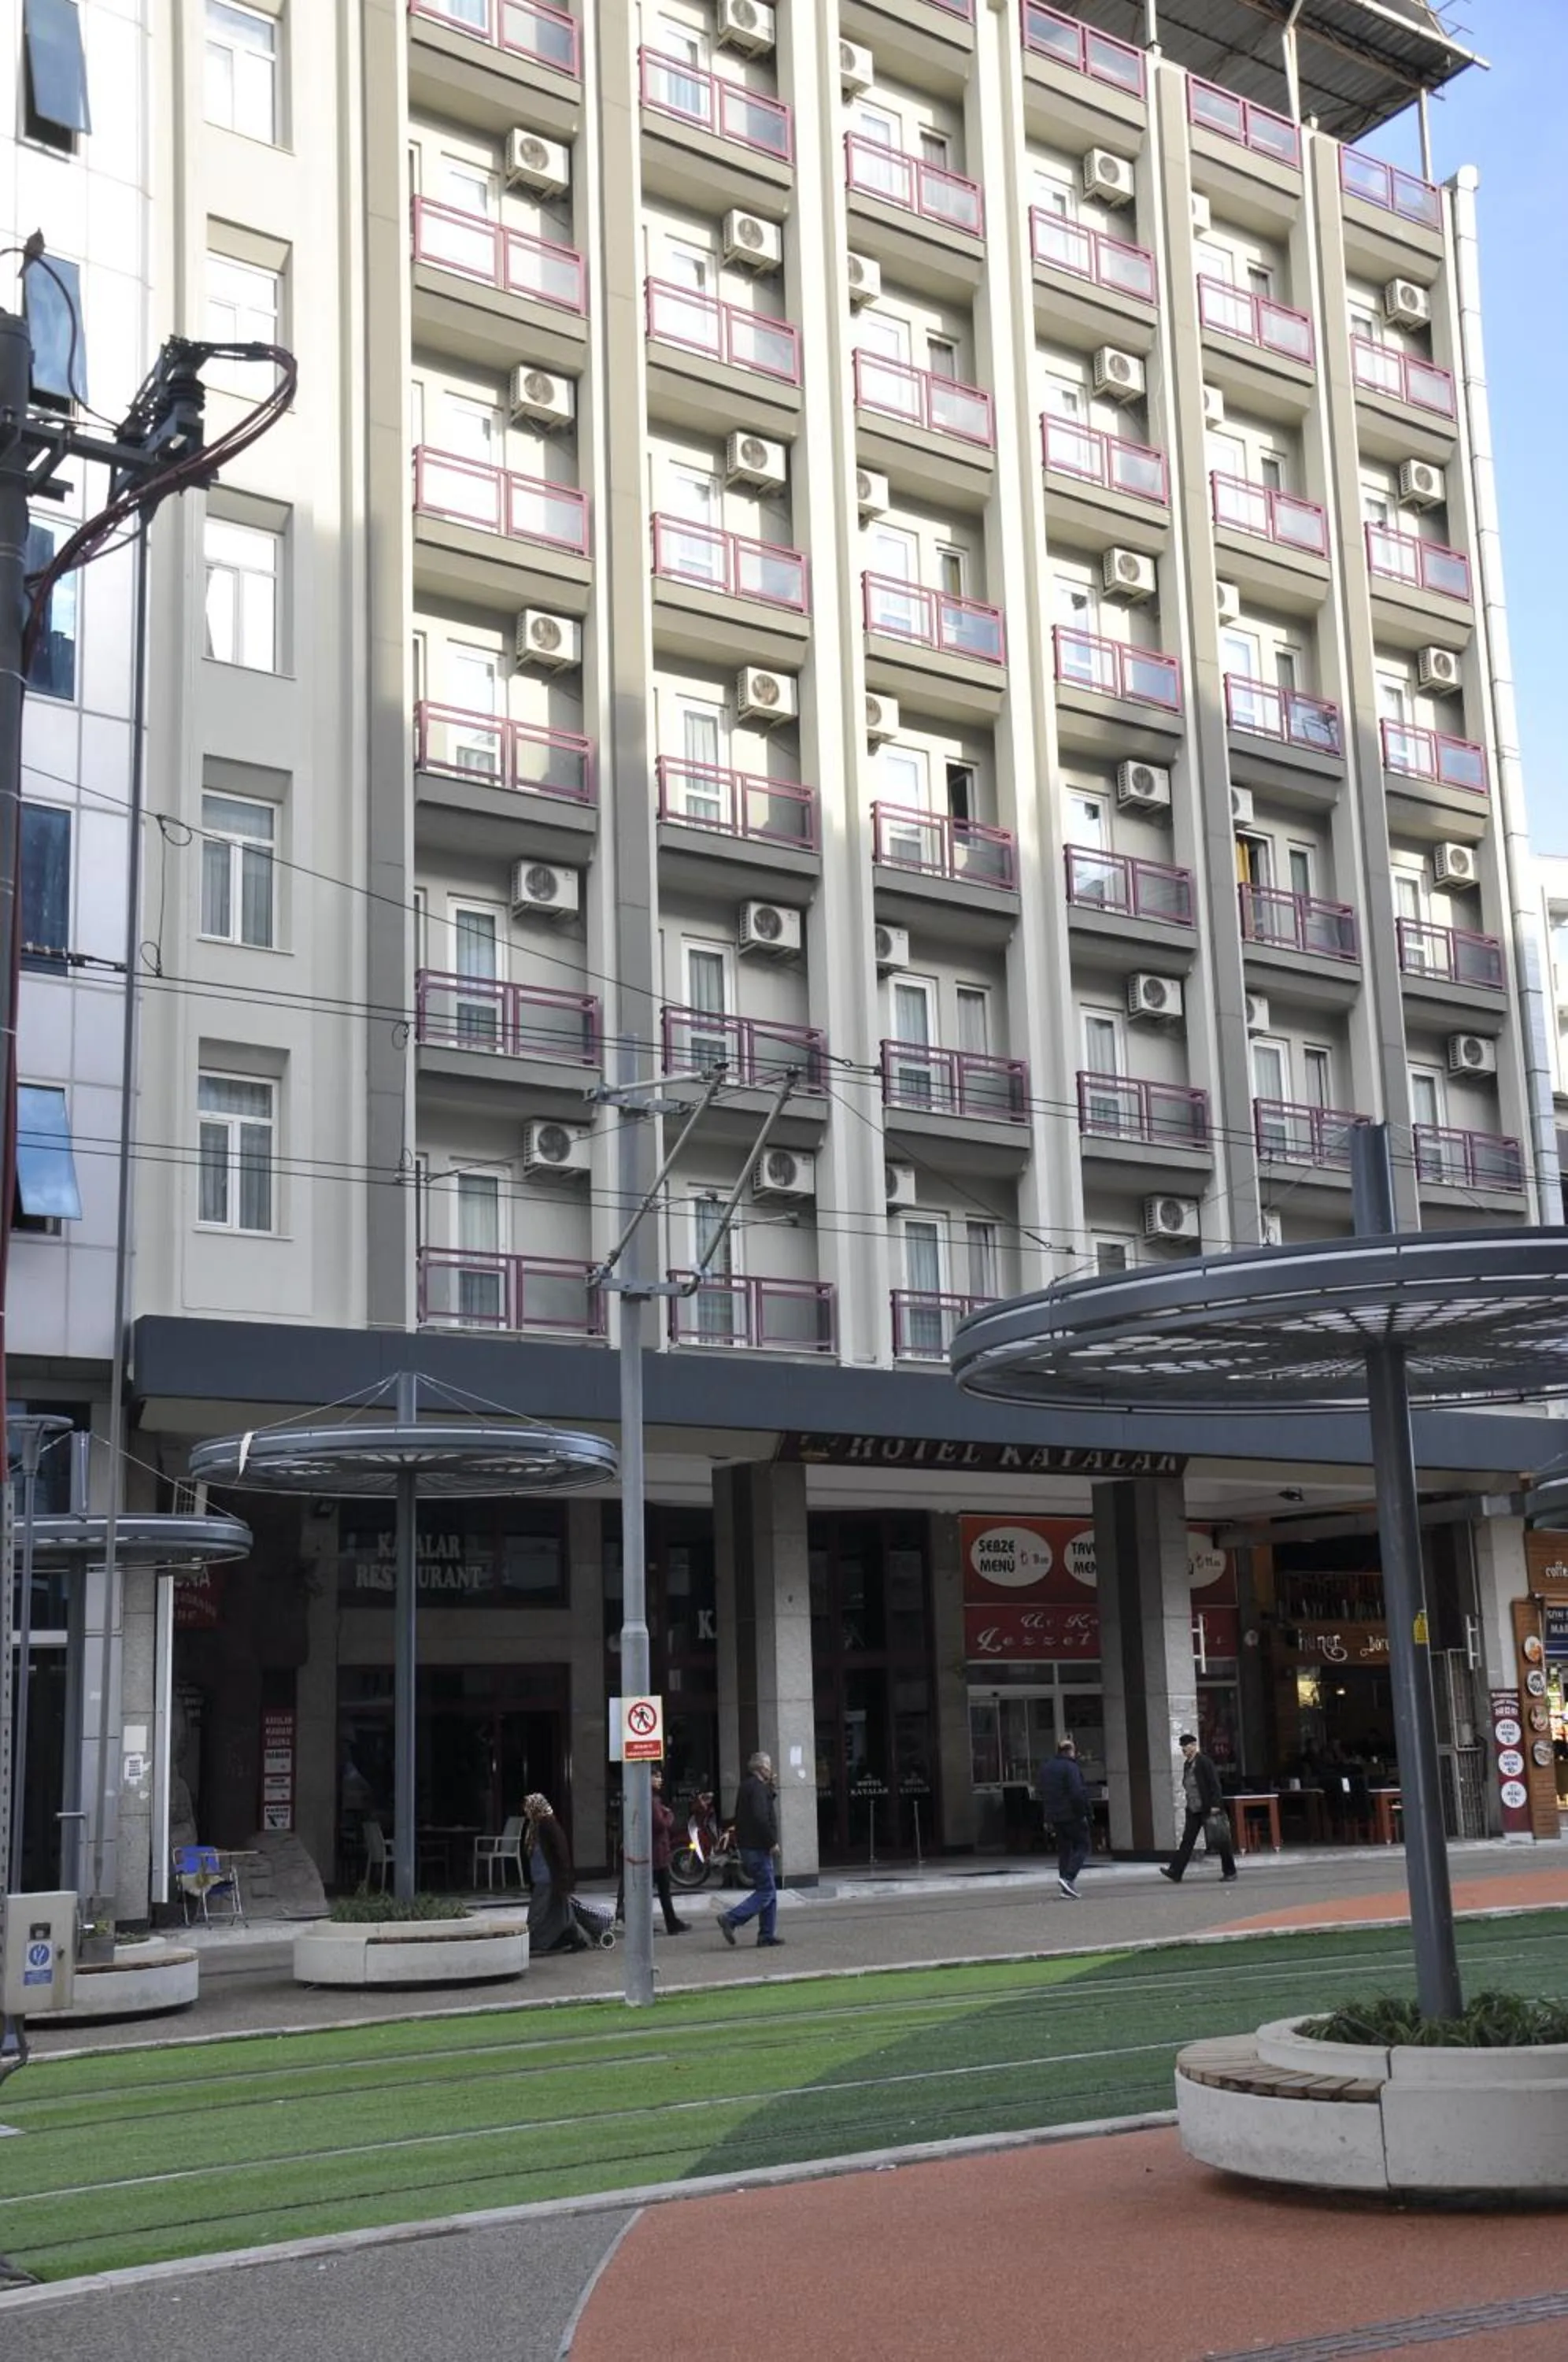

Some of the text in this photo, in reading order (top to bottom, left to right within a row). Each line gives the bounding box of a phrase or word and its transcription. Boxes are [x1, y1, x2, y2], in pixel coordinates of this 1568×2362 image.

[377, 1532, 461, 1558] KALAR
[978, 1539, 1015, 1553] SEBZE
[1071, 1542, 1096, 1555] TAV
[980, 1556, 1015, 1573] MENÜ
[1074, 1561, 1097, 1575] MEN
[355, 1564, 482, 1591] RESURANT
